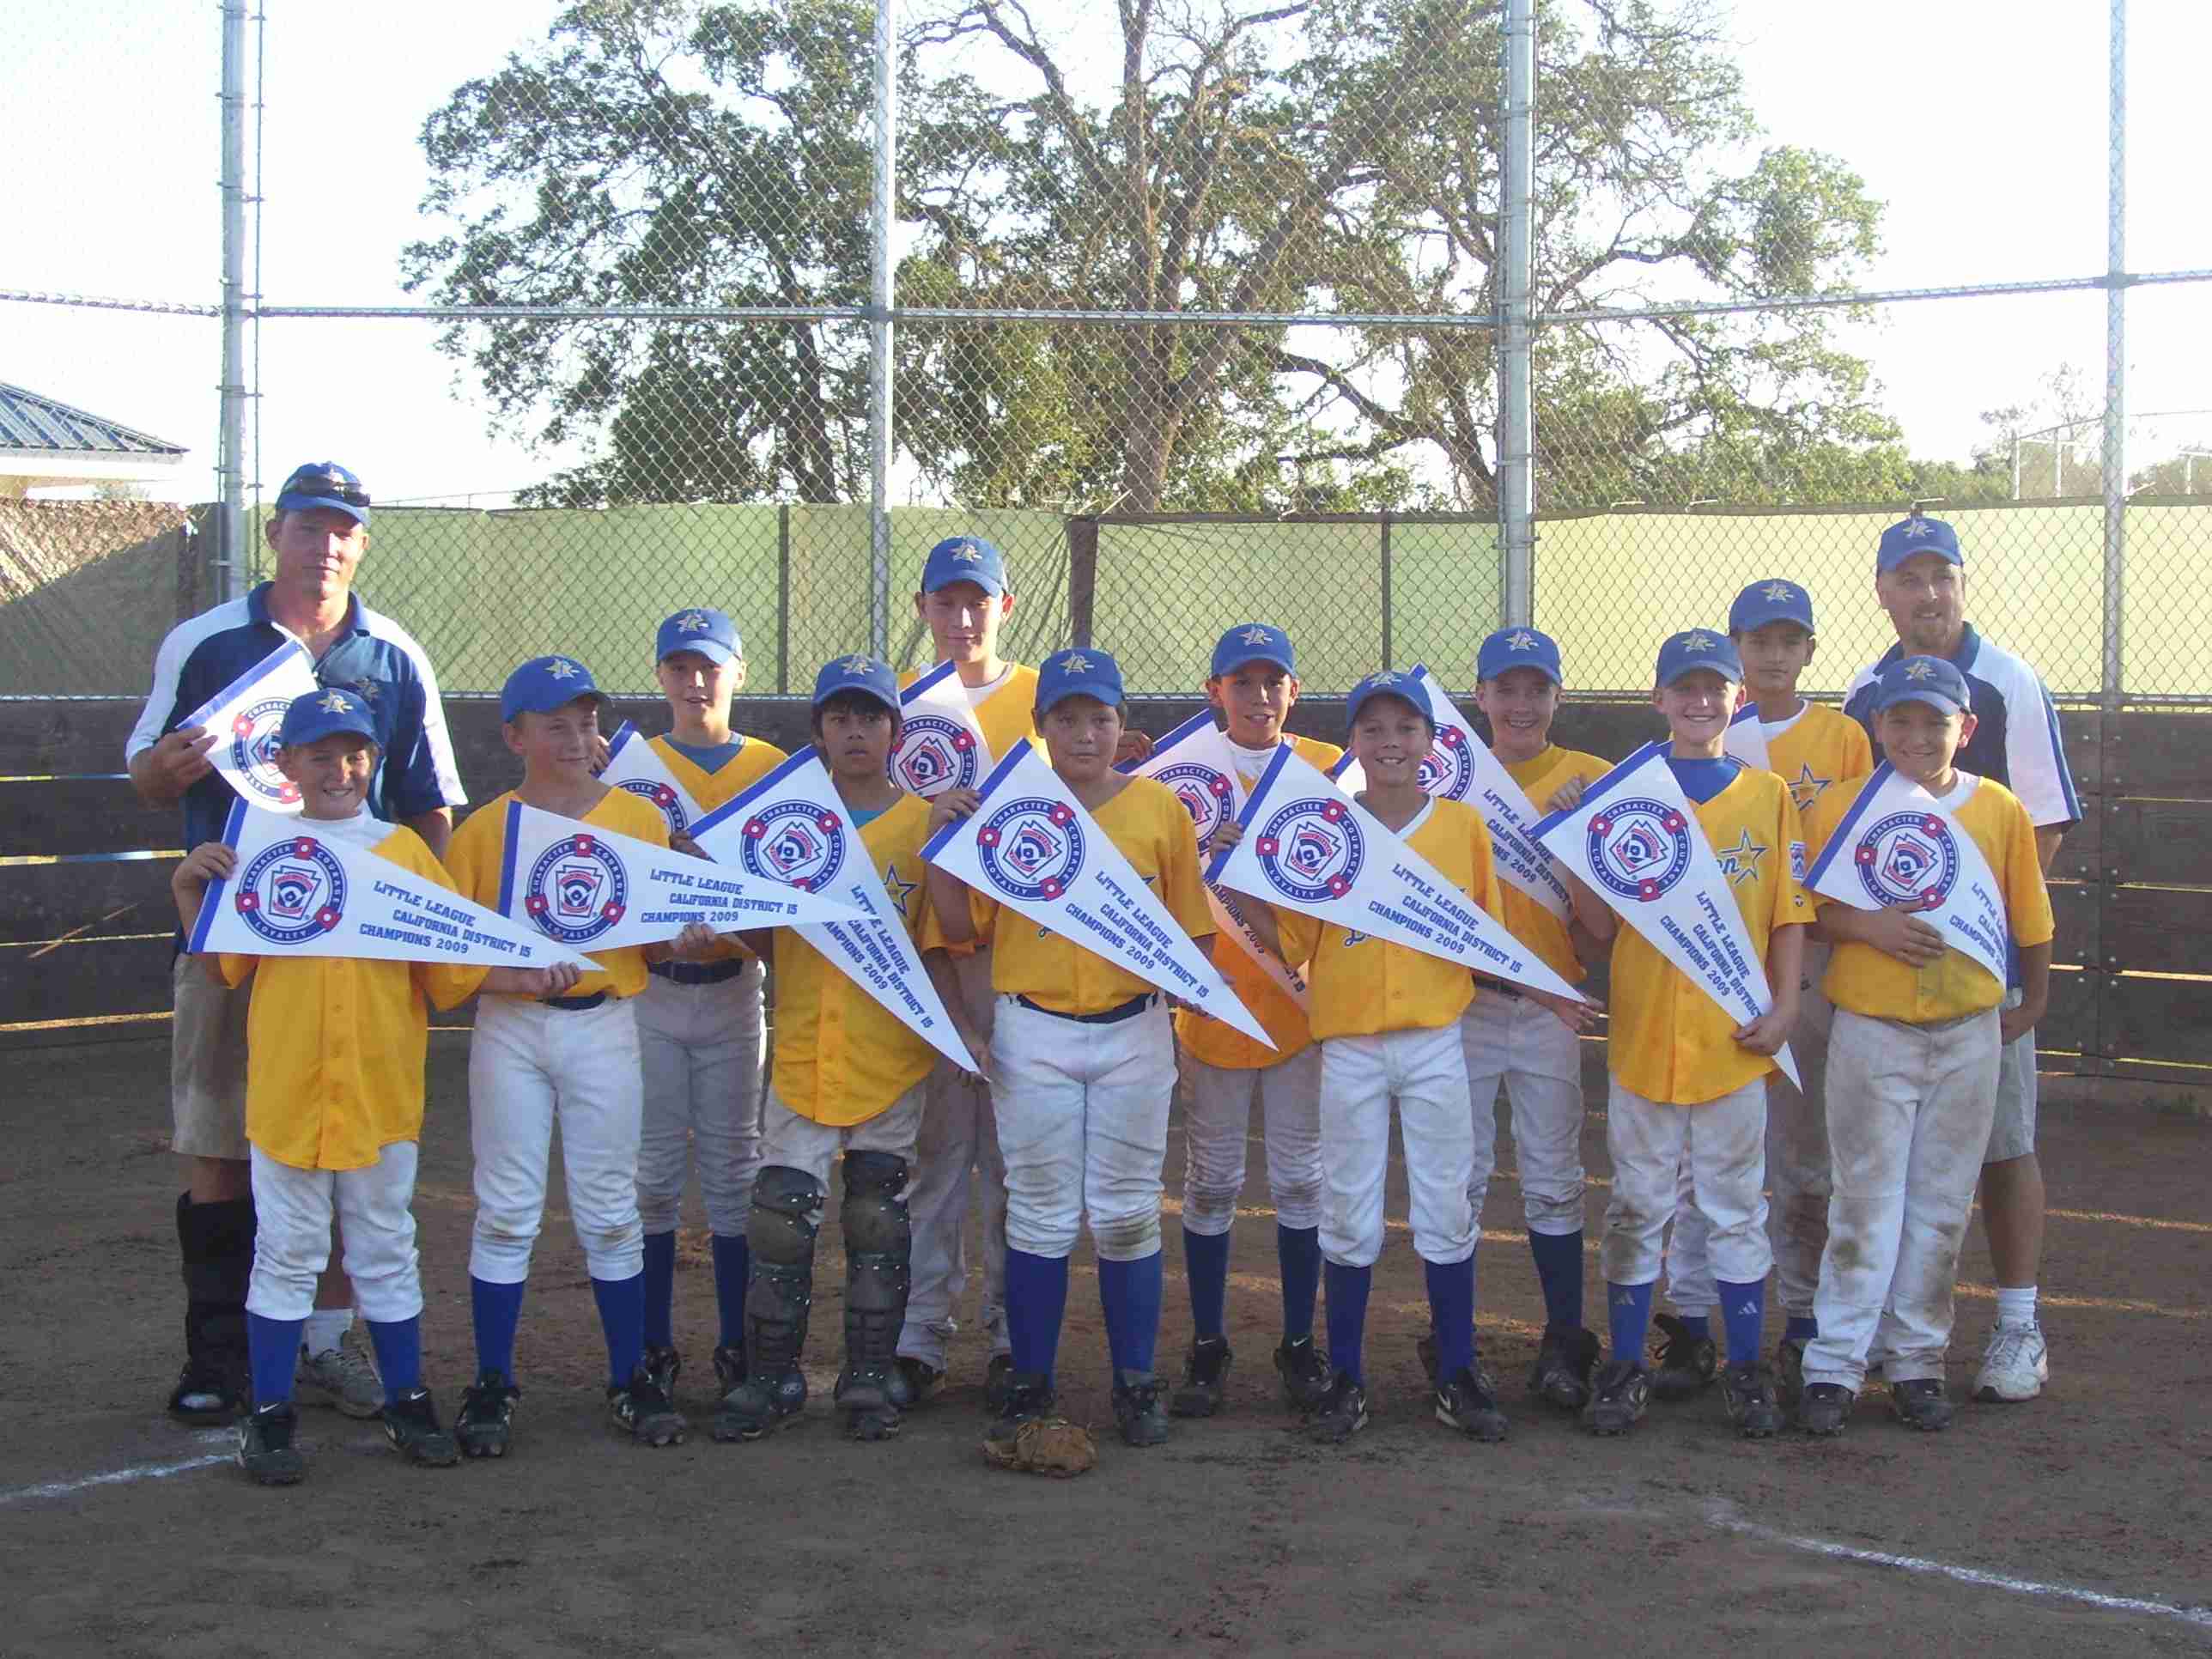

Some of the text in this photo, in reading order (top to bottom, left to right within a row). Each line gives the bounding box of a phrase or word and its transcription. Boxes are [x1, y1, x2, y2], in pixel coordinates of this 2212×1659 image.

[247, 702, 290, 719] CHARACT
[905, 720, 956, 733] HARACTER
[762, 805, 821, 822] CHARACTER
[992, 802, 1050, 827] CHARACTER
[1268, 803, 1321, 836] CHARACTER
[1483, 788, 1520, 825] LITTLE
[1607, 803, 1664, 818] CHARACTER
[1064, 825, 1080, 880] COURAGE
[1343, 819, 1360, 875] COURAGE
[1867, 816, 1920, 845] CHARACTER
[246, 845, 291, 890] CHARACTER
[316, 851, 343, 903] COURAGE
[649, 868, 744, 896] LITTLE LEAGUE
[816, 834, 841, 884] COURAGE
[986, 860, 1030, 895] LOYALTY
[1269, 868, 1316, 897] LOYALTY
[1486, 818, 1539, 866] CALIFORNIA
[1534, 861, 1571, 905] DISTRICT
[1510, 858, 1538, 884] 2009
[1592, 848, 1627, 890] LOYALTY
[373, 880, 477, 927] LITTLE LEAGUE
[640, 910, 739, 923] CHAMPIONS 2009
[668, 892, 799, 915] CALIFORNIA DISTRICT 15
[1094, 870, 1174, 949] LITTLE LEAGUE
[1204, 878, 1244, 928] HAMPIONS
[1391, 863, 1480, 931] LITTLE LEAGUE
[255, 921, 307, 939] LOYALTY
[359, 922, 470, 955] CHAMPIONS 2009
[392, 908, 532, 958] CALIFORNIA DISTRICT 15
[1065, 902, 1156, 970] CHAMPIONS 2009
[1099, 902, 1211, 999] CALIFORNIA DISTRICT 15
[1367, 900, 1466, 955] CHAMPIONS 2009
[1401, 895, 1523, 974] CALIFORNIA DISTRICT 15
[1696, 890, 1751, 980] LITTLE LEAGUE
[822, 920, 890, 991] AMPIONS 2009
[847, 920, 935, 1030] CALIFORNIA DISTRICT 15
[877, 928, 911, 975] LEAGUE
[1660, 915, 1731, 997] CHAMPIONS 2009
[1692, 923, 1763, 1018] CALIFORNIA DISTRICT
